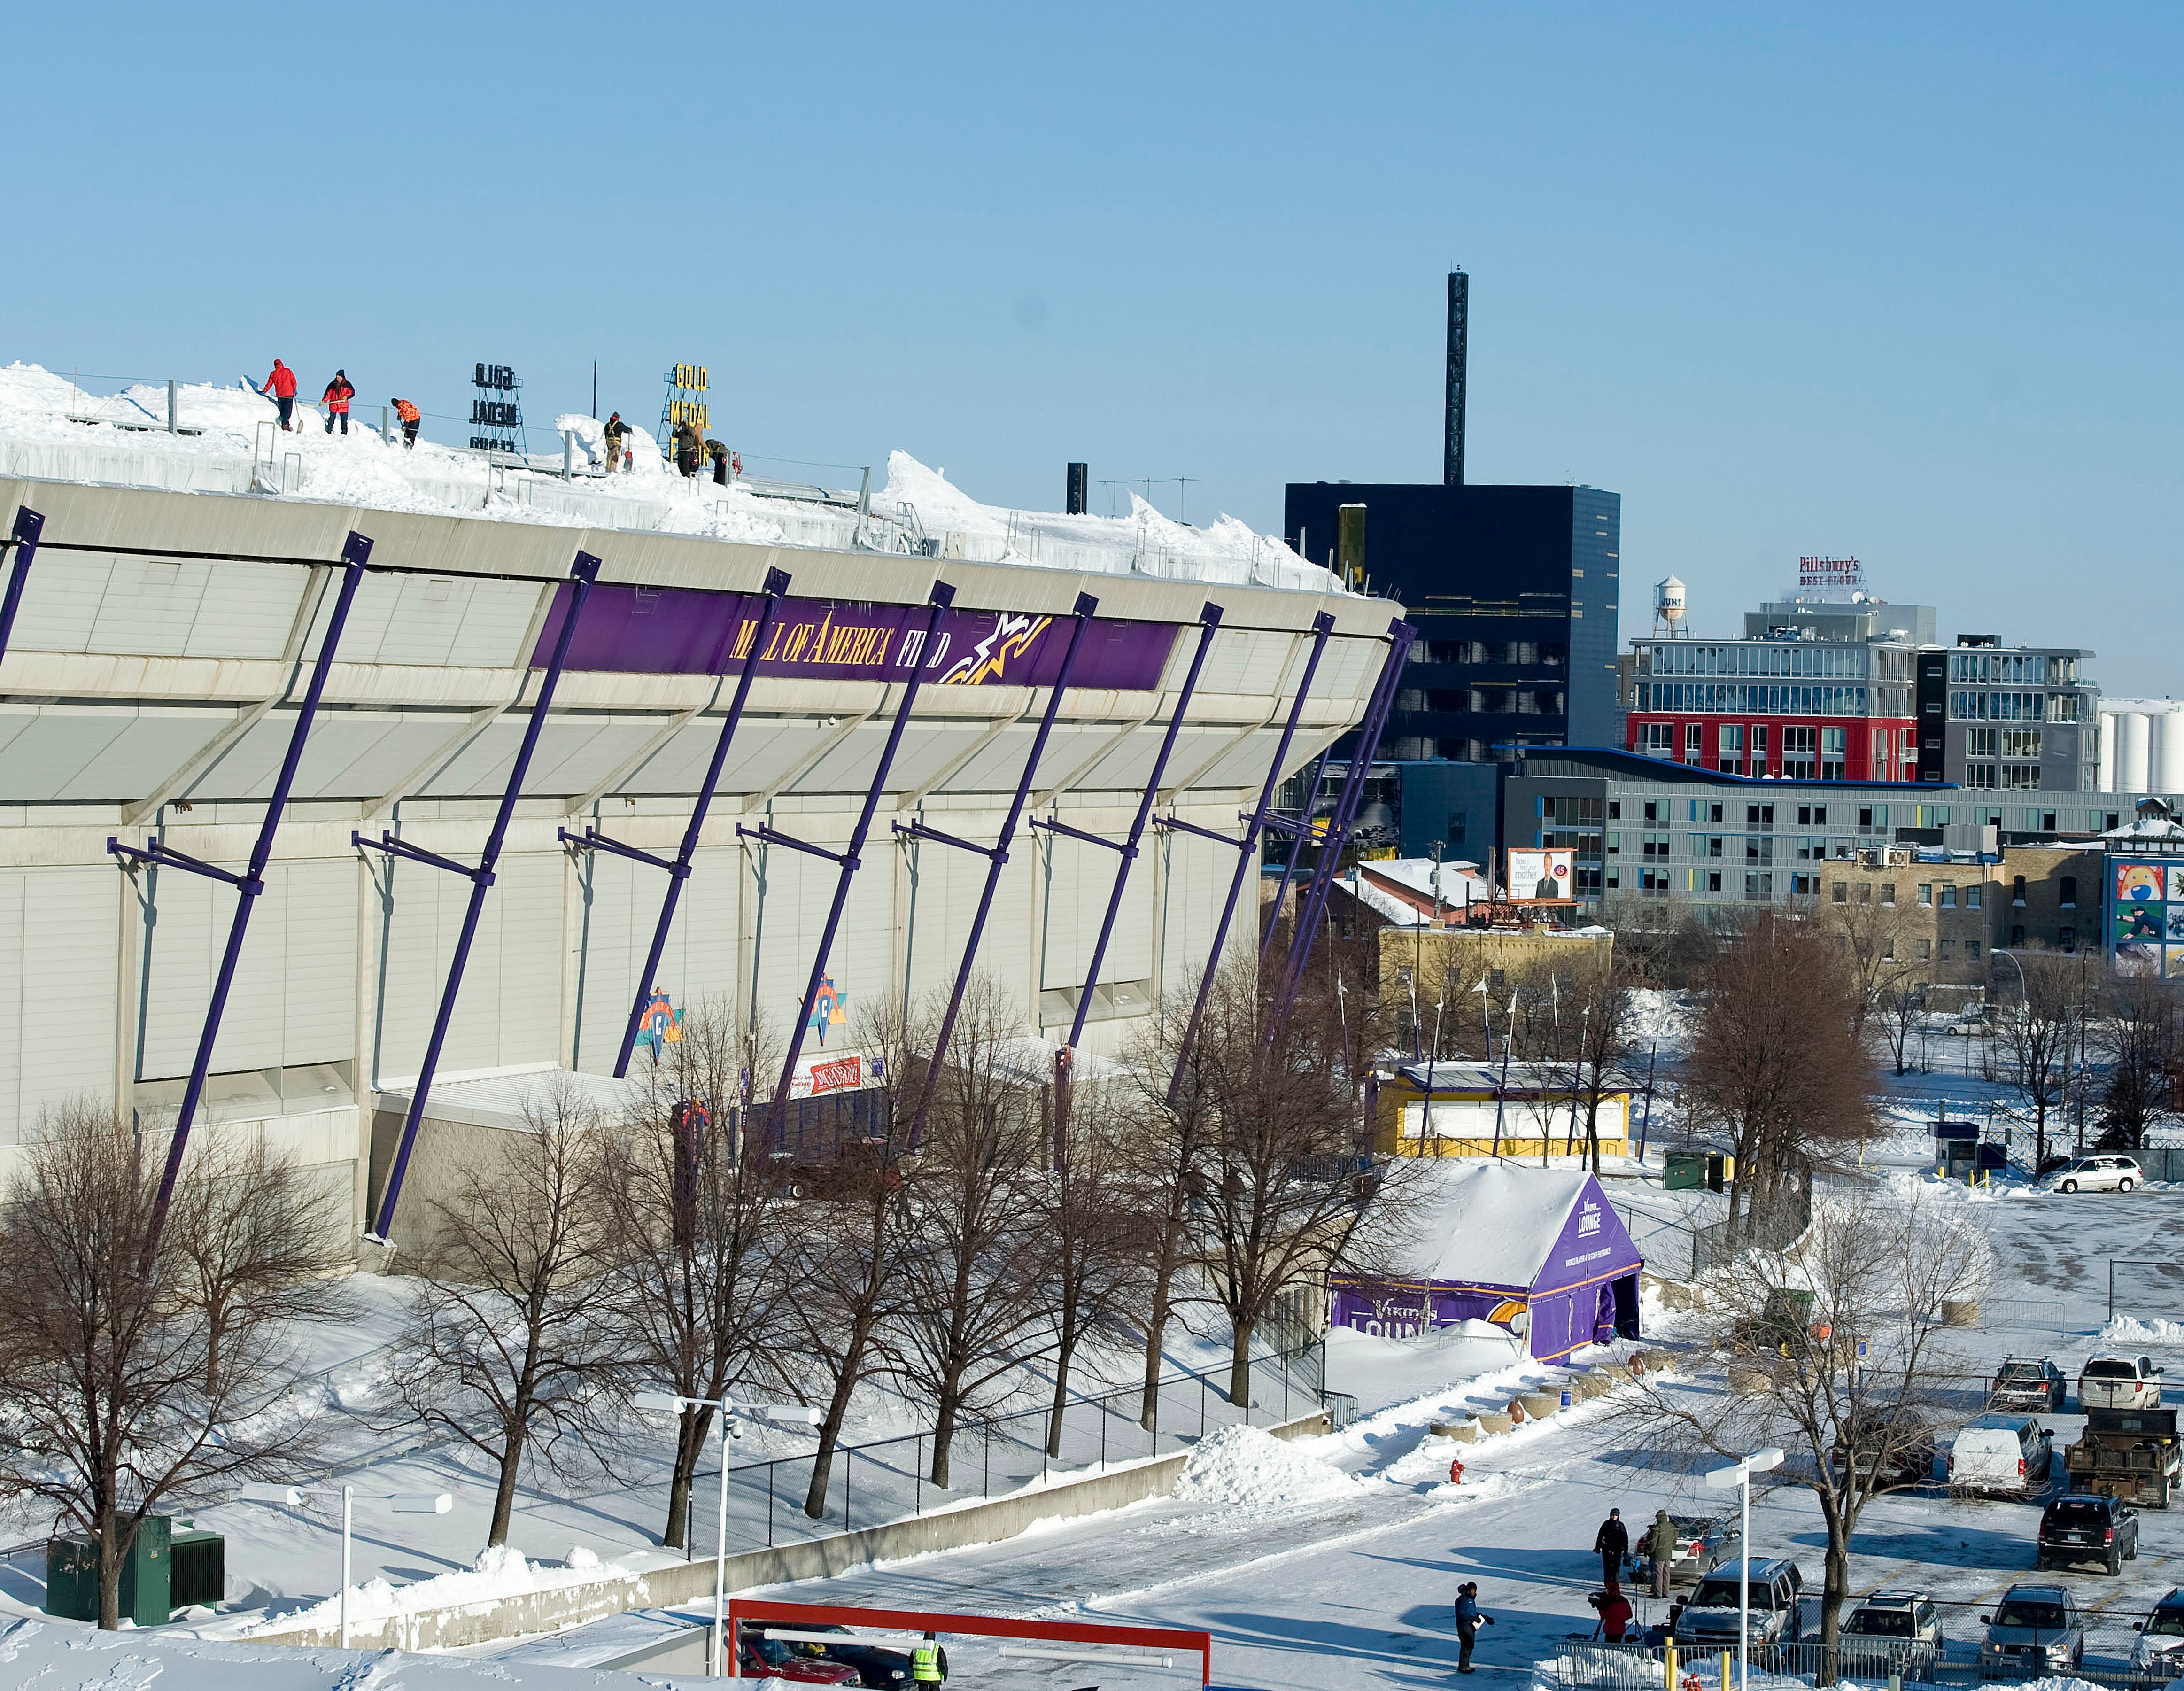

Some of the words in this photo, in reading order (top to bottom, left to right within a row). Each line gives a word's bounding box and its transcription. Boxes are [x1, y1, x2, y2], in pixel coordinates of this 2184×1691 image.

[675, 363, 707, 391] GOLD
[670, 399, 711, 430] MEDAL
[1800, 556, 1859, 574] Pillsbury's
[1800, 576, 1823, 586] BEST
[729, 619, 786, 660] ML
[782, 622, 815, 662] OF
[805, 610, 894, 665] AMERICA
[895, 629, 951, 668] FID
[1515, 869, 1537, 879] mother
[821, 999, 828, 1018] C
[656, 1016, 662, 1035] C
[1578, 1212, 1601, 1233] LOUNGE
